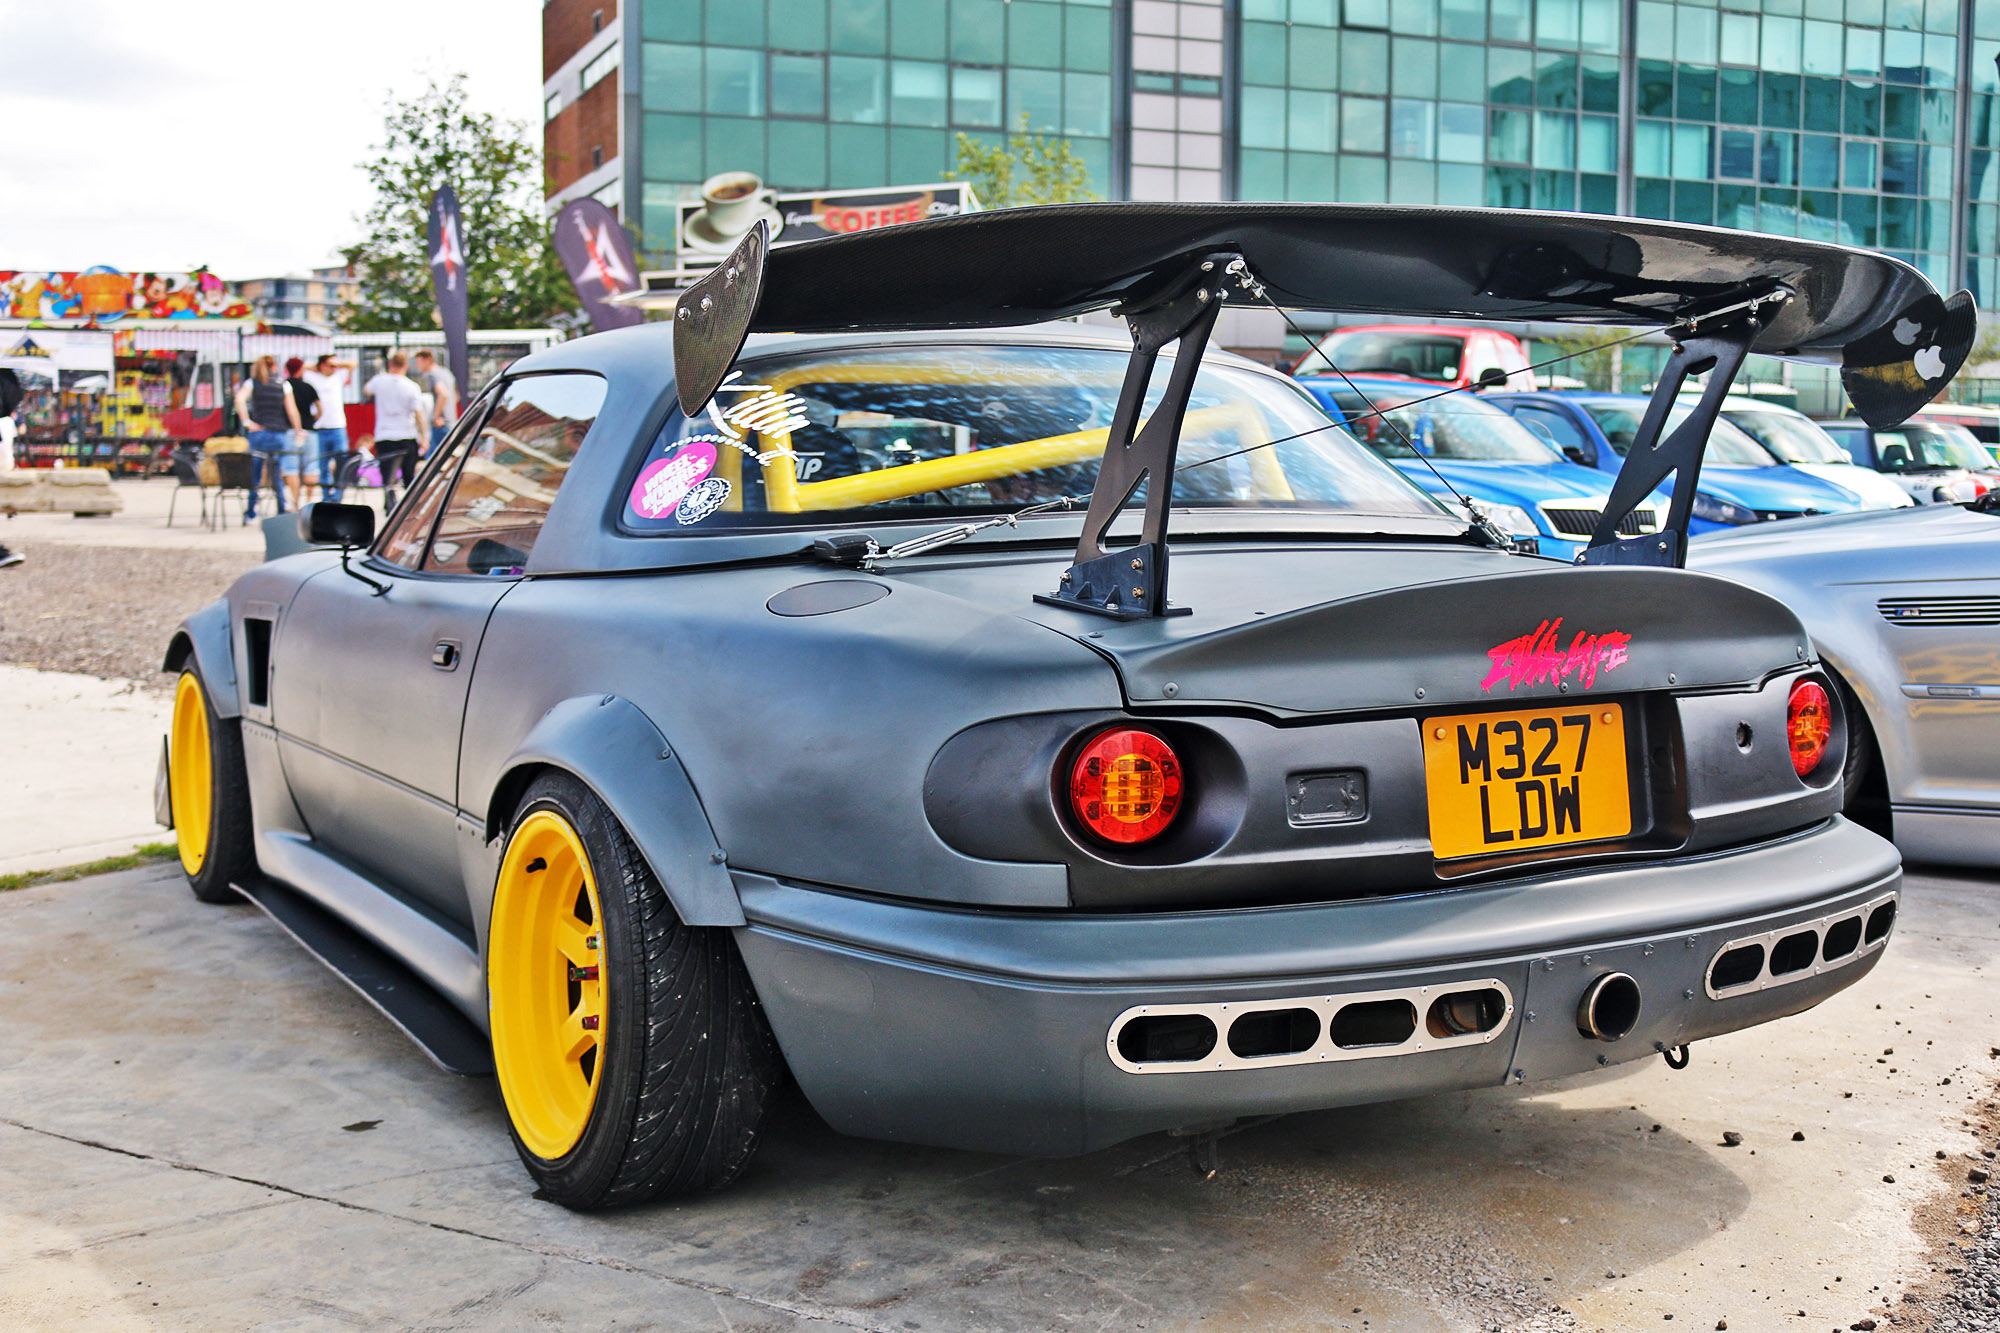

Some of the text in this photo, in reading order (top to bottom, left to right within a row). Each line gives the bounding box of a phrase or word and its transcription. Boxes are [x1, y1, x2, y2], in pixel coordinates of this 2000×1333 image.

[824, 201, 921, 233] COFFEE
[1456, 714, 1592, 785] M327
[1479, 775, 1582, 845] LDW
